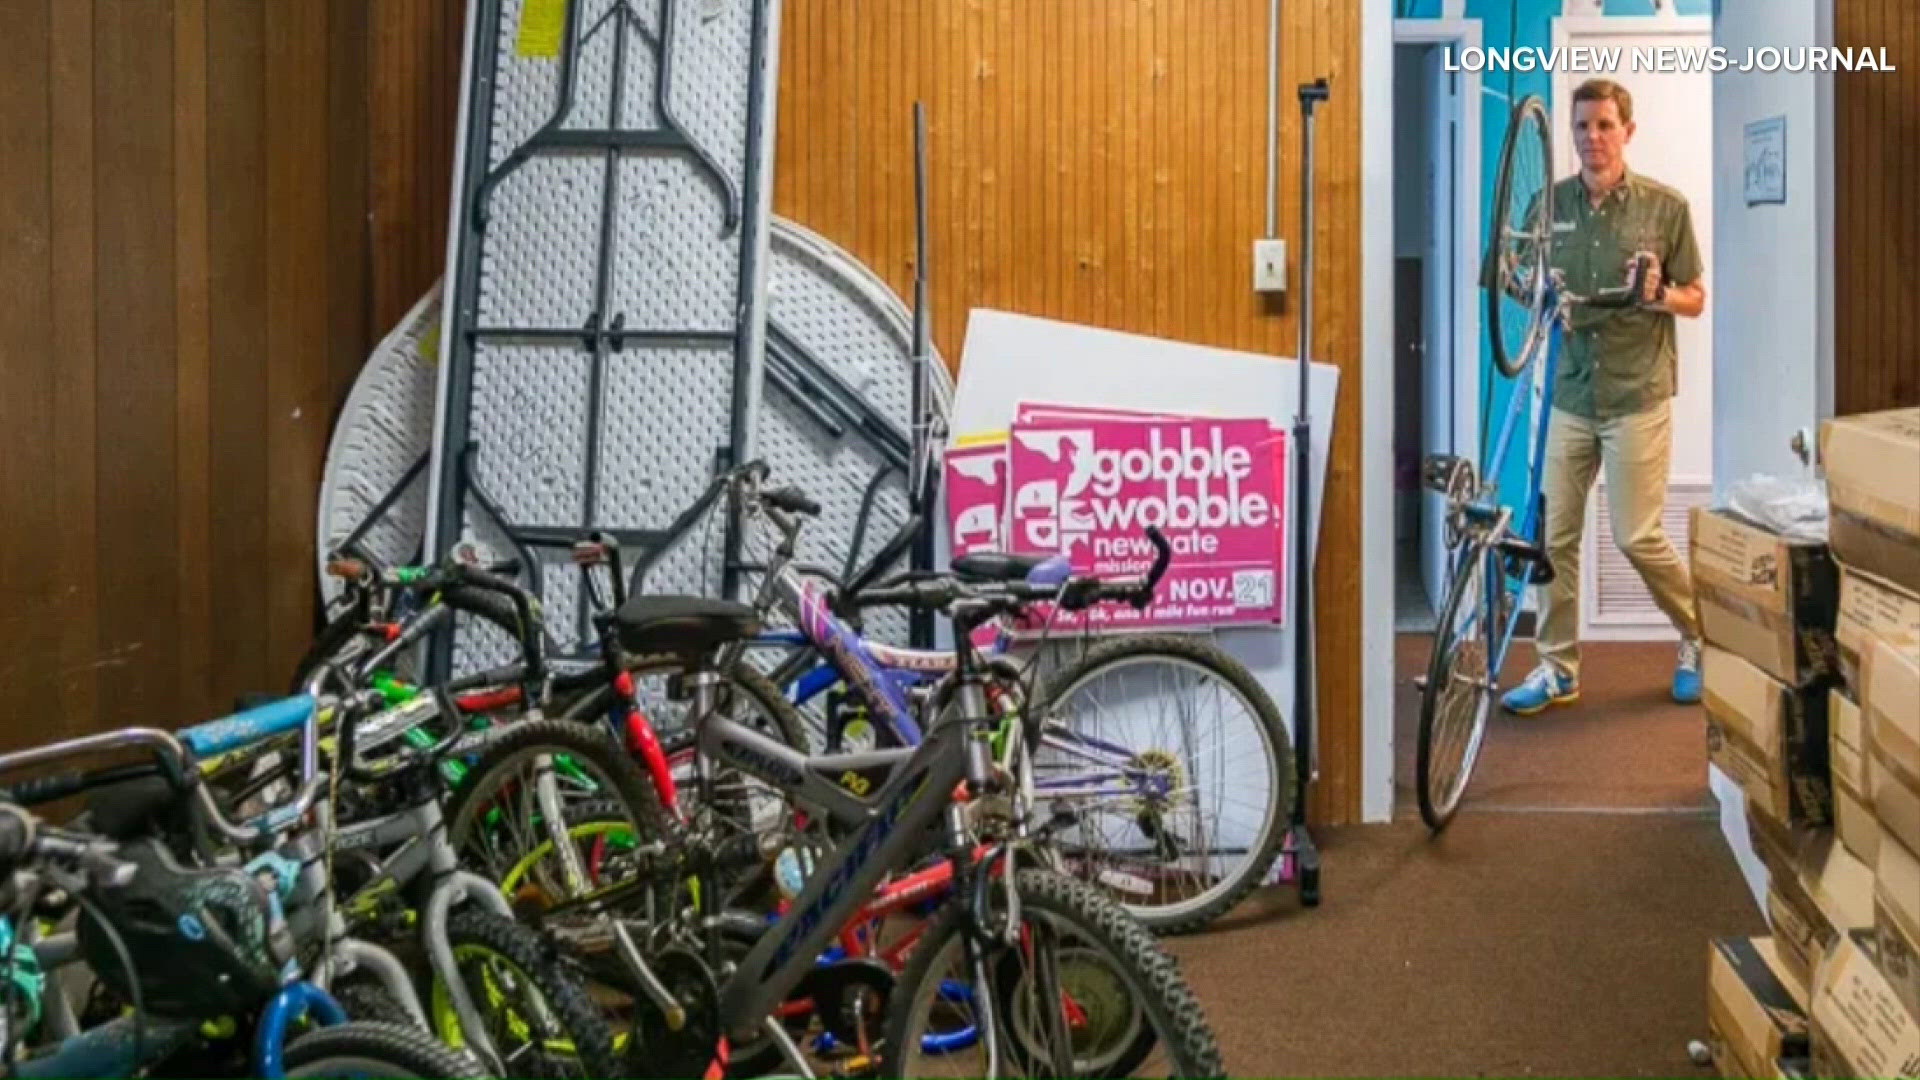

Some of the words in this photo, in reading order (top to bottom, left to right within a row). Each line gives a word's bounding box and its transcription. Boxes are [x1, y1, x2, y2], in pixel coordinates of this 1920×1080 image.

[1092, 427, 1251, 496] gobble
[1170, 579, 1233, 600] NOV.
[1236, 574, 1271, 606] 21
